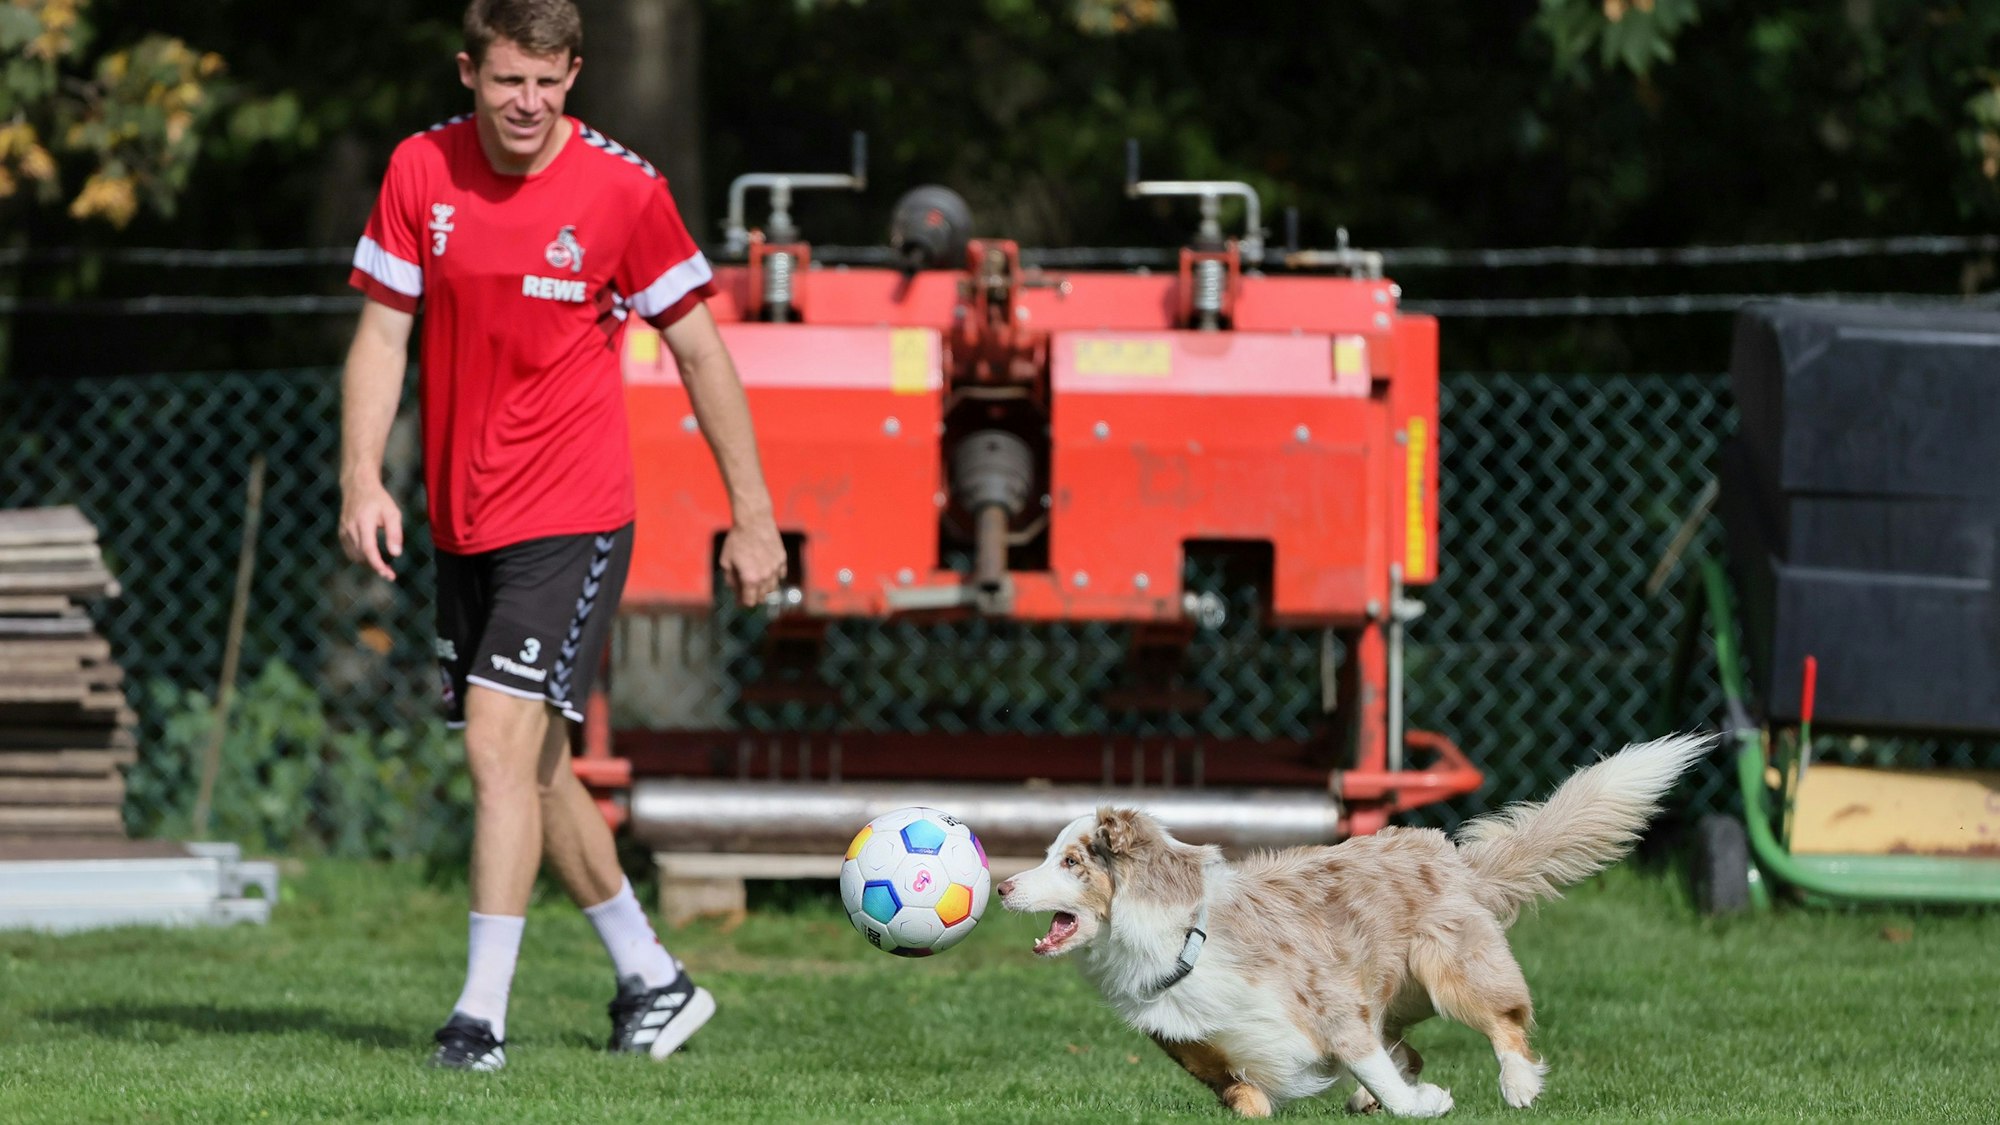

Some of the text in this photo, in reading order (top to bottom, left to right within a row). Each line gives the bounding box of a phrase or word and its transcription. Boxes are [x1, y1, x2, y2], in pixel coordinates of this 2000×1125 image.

[432, 231, 447, 256] 3
[522, 274, 586, 303] REWE
[519, 637, 541, 664] 3
